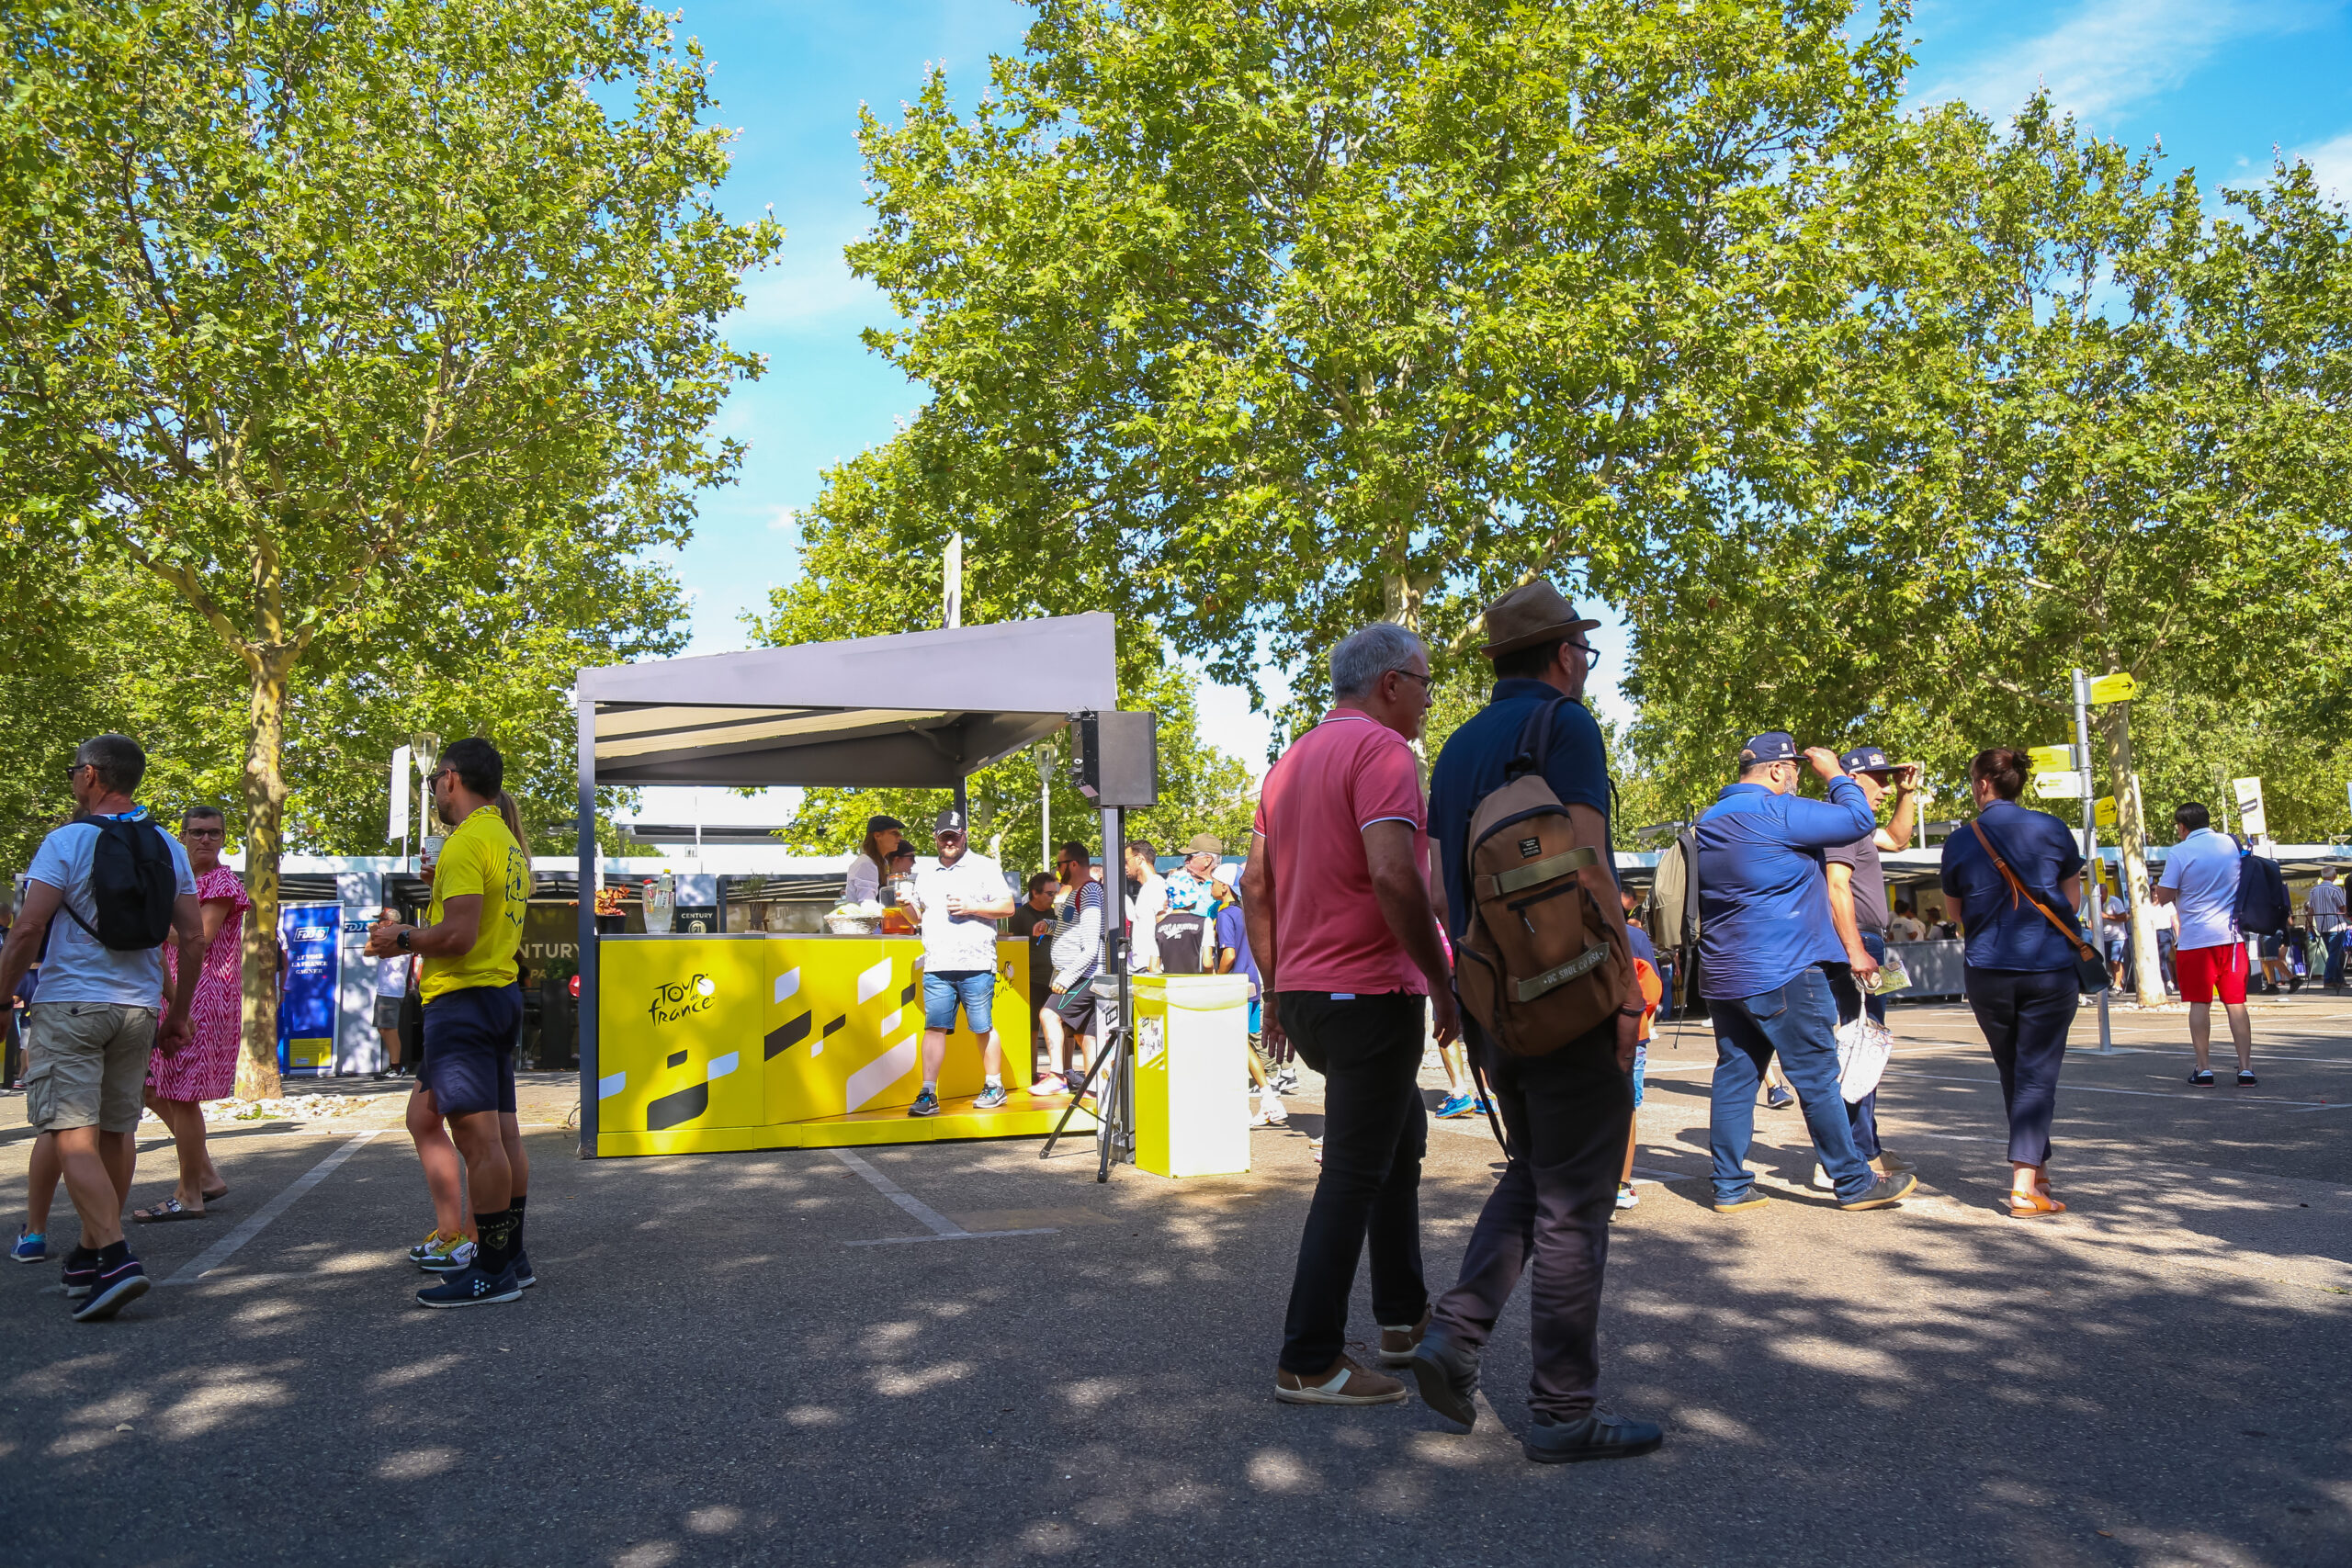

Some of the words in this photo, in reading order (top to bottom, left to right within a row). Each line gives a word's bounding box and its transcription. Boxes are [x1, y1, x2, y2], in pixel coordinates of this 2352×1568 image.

[519, 943, 580, 959] NTURY
[1547, 974, 1557, 984] DC
[1558, 964, 1577, 979] SHOE
